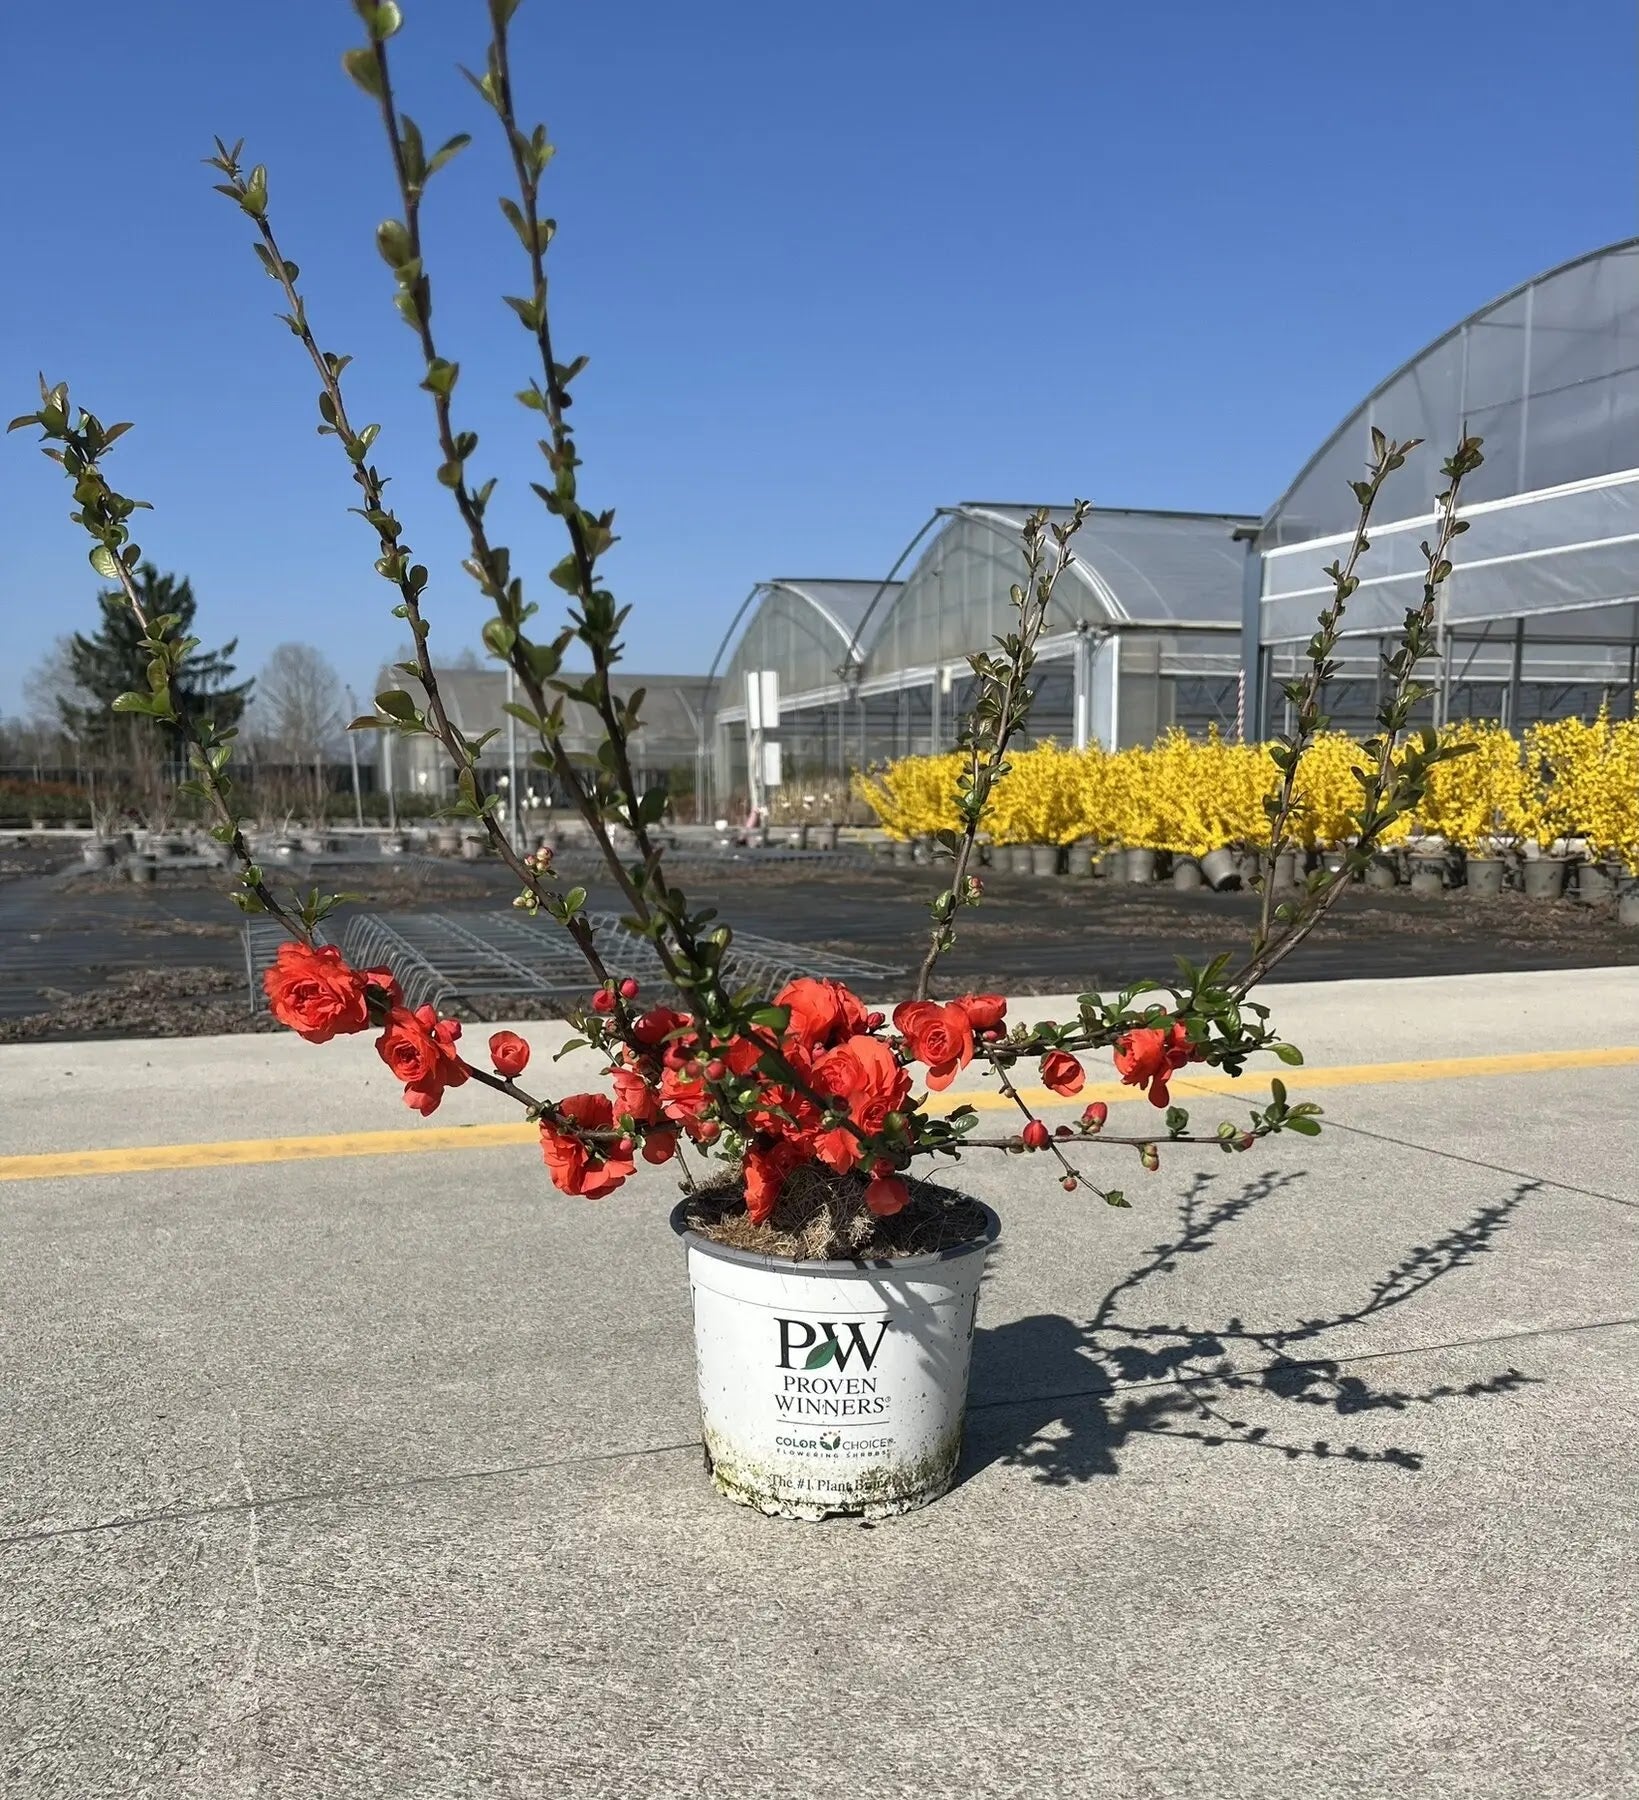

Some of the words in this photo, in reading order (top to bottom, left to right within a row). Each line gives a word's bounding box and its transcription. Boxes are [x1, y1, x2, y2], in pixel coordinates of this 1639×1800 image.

[773, 1317, 894, 1373] PW
[784, 1375, 878, 1395] PROVEN
[776, 1436, 817, 1449] COLOR
[776, 1448, 839, 1458] FLOWERING
[770, 1474, 793, 1488] The
[817, 1479, 852, 1492] Plant
